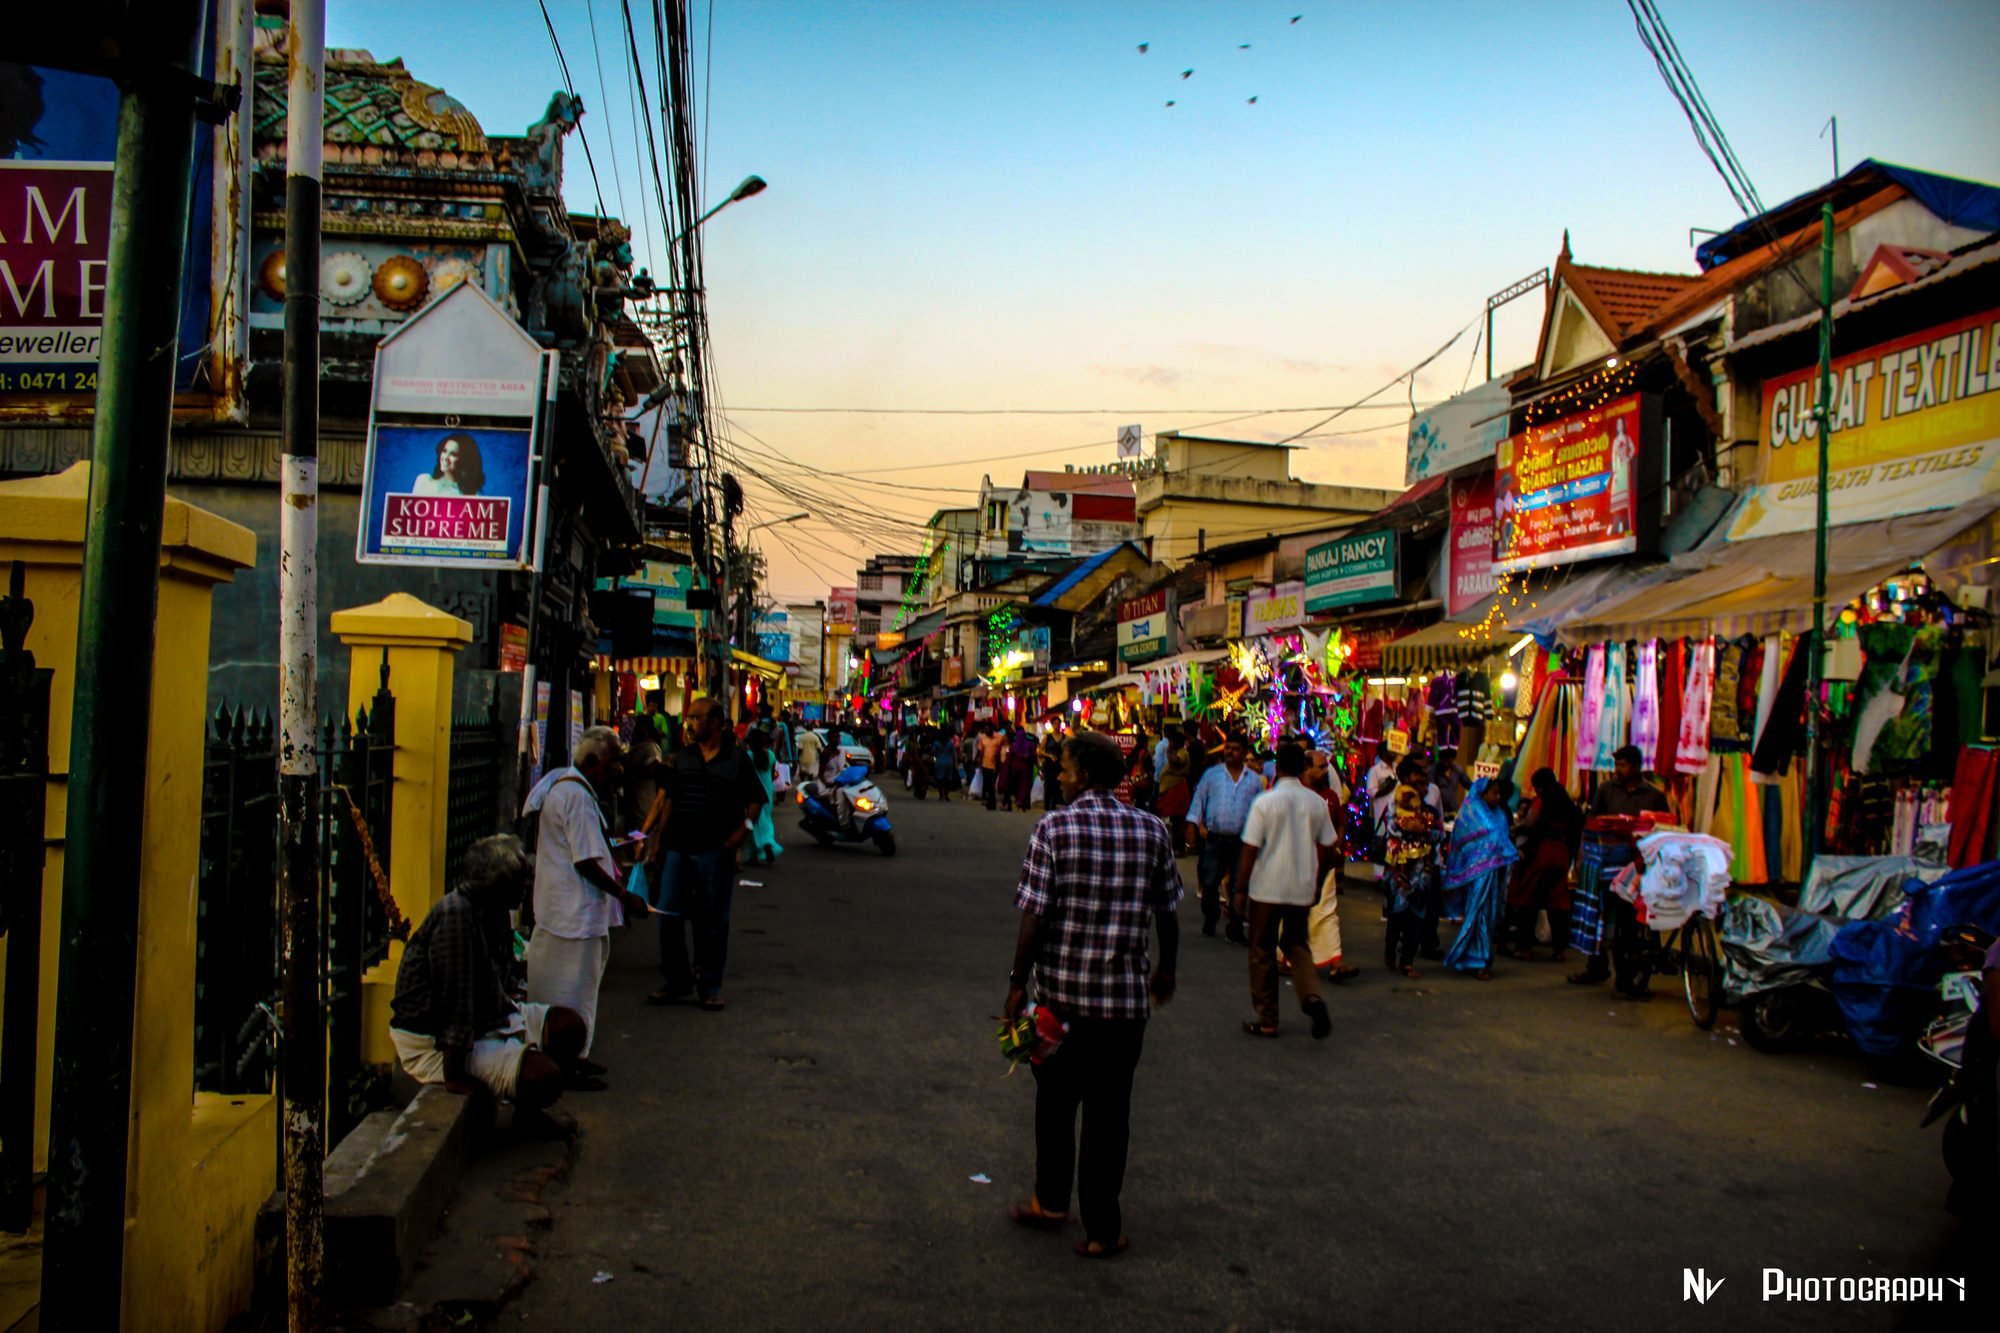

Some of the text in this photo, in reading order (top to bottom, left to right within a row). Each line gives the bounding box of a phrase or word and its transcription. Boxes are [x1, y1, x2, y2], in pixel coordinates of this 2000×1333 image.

[0, 186, 89, 244] M
[19, 373, 66, 390] 0471
[391, 379, 526, 392] PARKING RESTRICTED AREA
[1567, 454, 1604, 479] BAZAR
[1878, 447, 1984, 482] TEXTILES
[400, 499, 495, 520] KOLLAM
[390, 518, 499, 540] SUPREME
[1307, 536, 1386, 573] PANKAJ FANCY
[1133, 594, 1158, 617] TITAN
[1476, 763, 1499, 774] TOP
